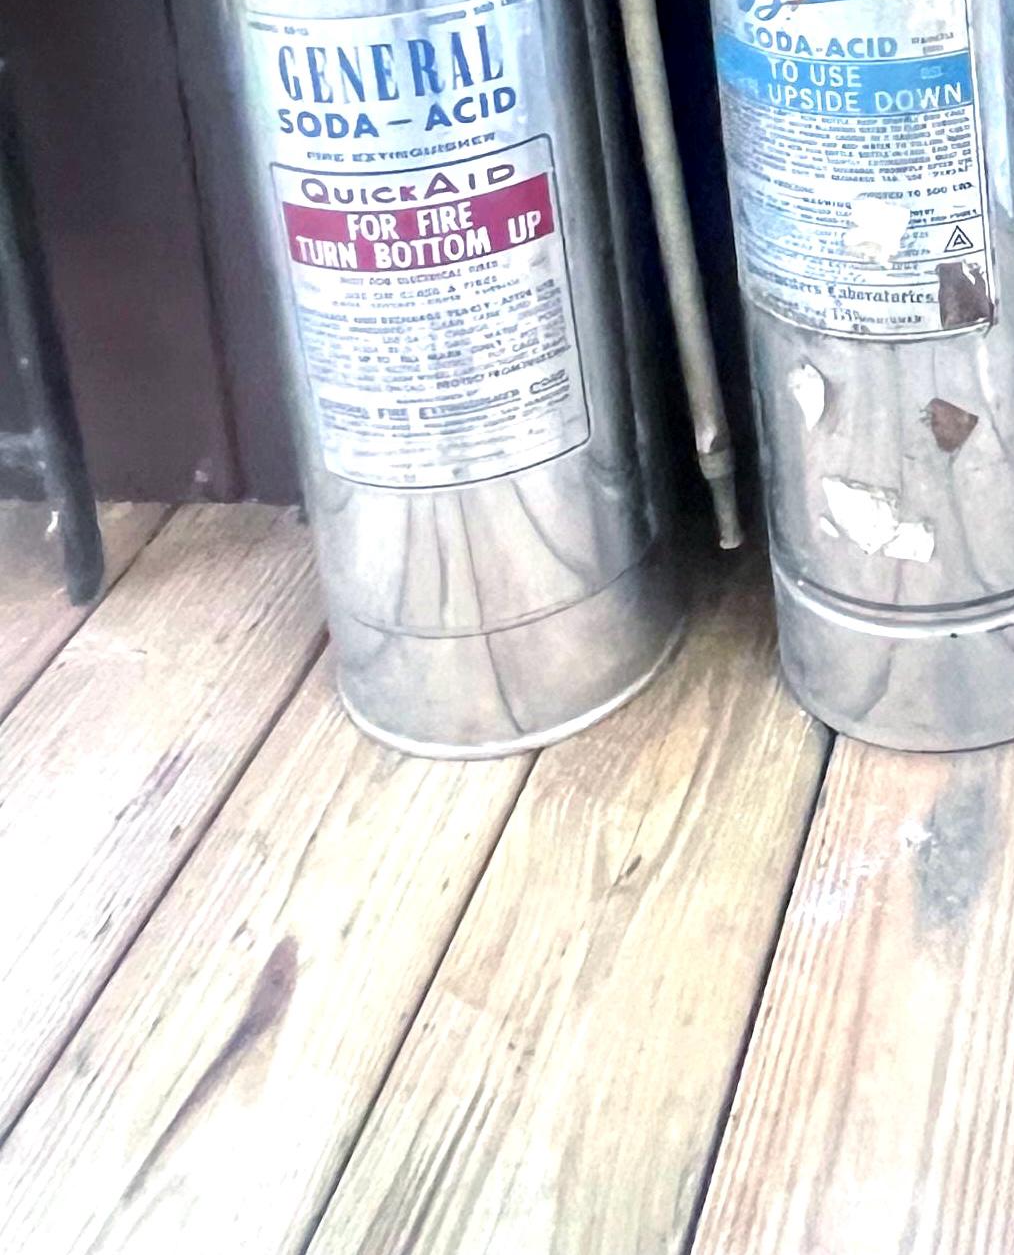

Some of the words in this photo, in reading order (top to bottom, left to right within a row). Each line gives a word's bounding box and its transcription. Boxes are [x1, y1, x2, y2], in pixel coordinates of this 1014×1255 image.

[277, 24, 505, 104] GENERAL
[767, 58, 799, 83] TO
[809, 65, 863, 88] USE
[277, 108, 380, 138] SODA
[424, 86, 517, 131] ACID
[767, 82, 863, 113] UPSIDE
[874, 81, 962, 112] DOWN
[294, 235, 358, 270] TURN
[374, 225, 492, 270] BOTTOM
[506, 210, 542, 244] UP
[346, 213, 400, 242] FOR
[415, 201, 474, 237] FIRE
